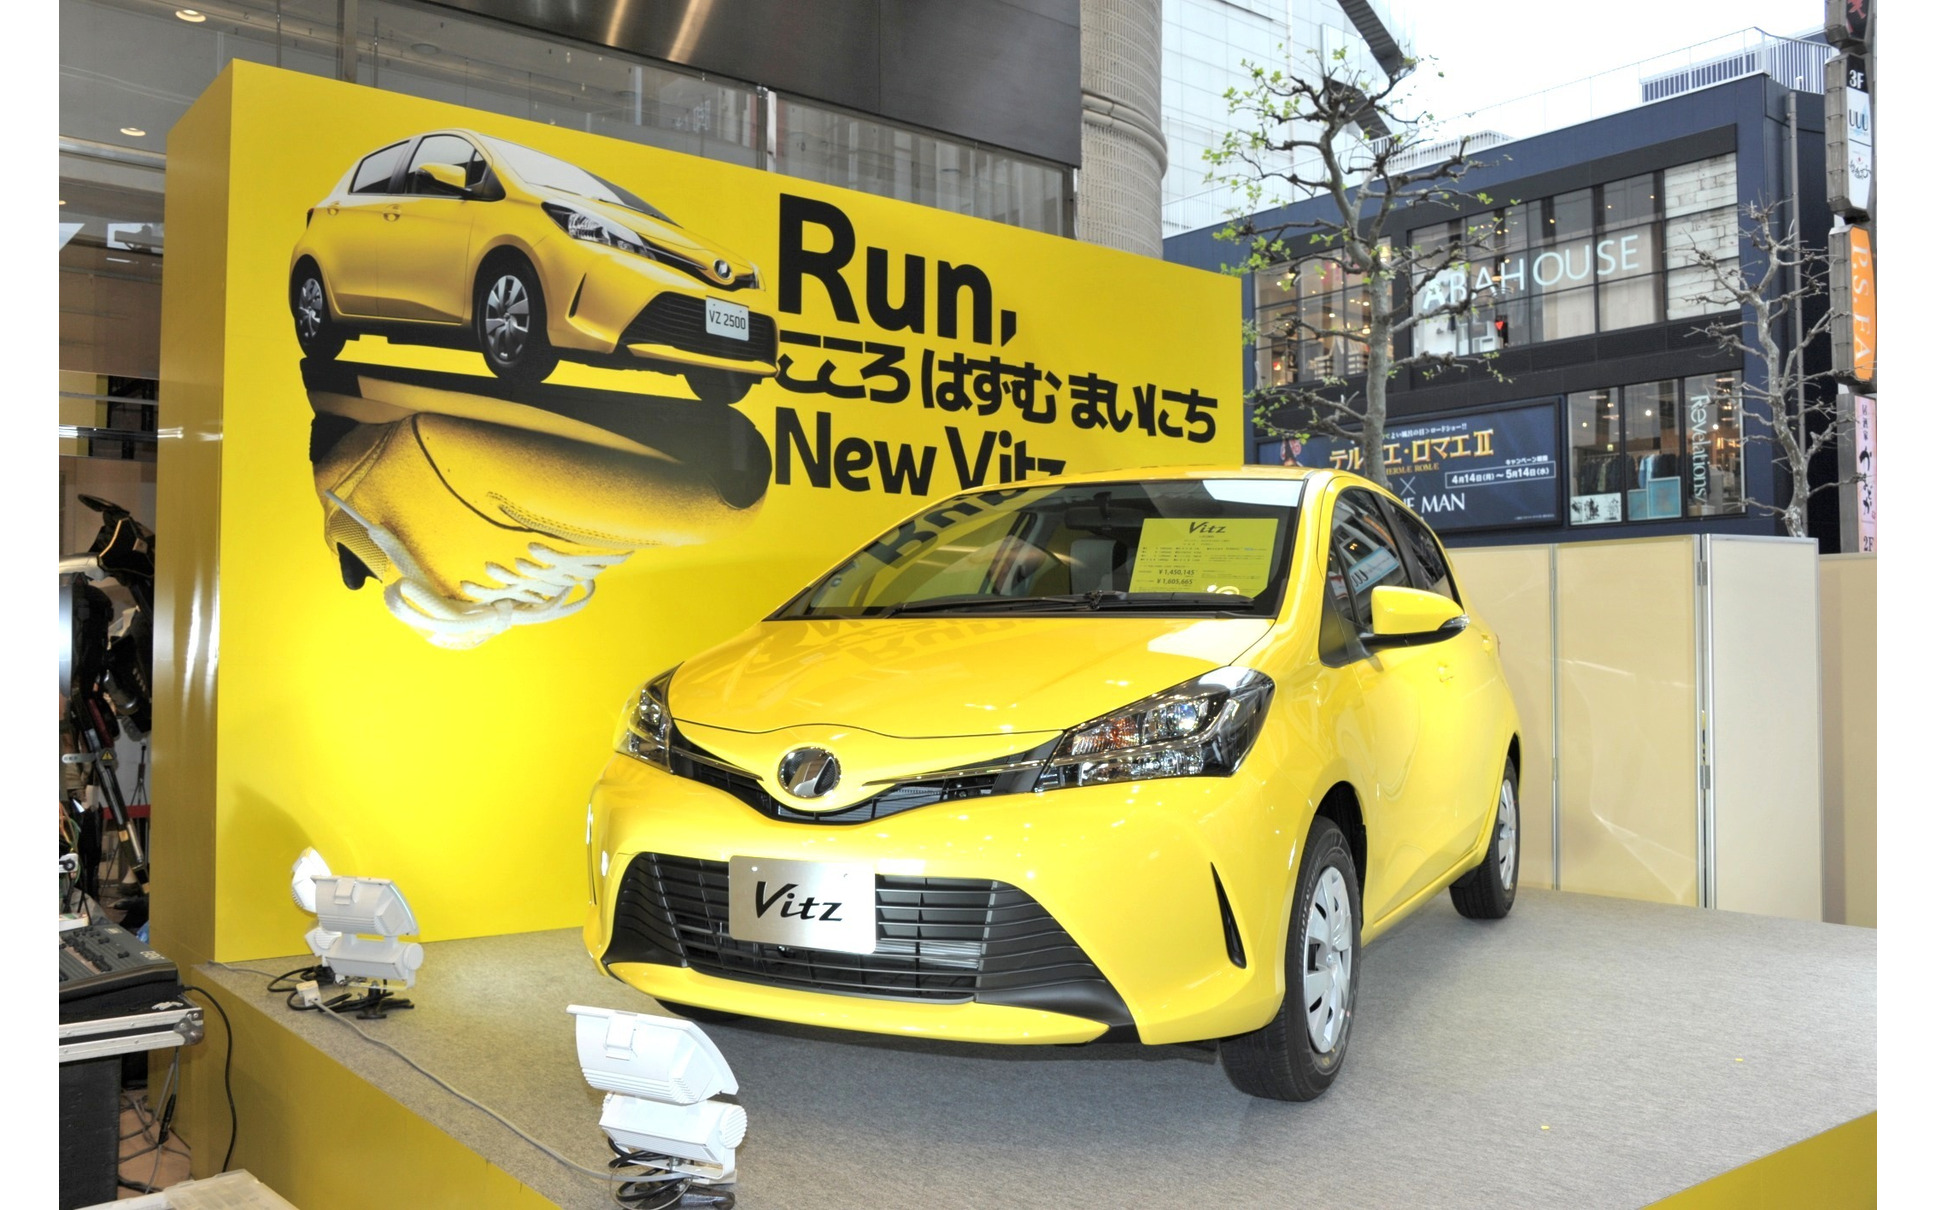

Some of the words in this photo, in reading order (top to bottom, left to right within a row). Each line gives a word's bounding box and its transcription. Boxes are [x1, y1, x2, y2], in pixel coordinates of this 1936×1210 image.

[1849, 69, 1865, 89] 3F
[778, 193, 1017, 346] Run,
[1423, 234, 1639, 309] ABAHOUSE
[709, 310, 721, 325] VZ
[724, 313, 746, 330] 2500
[777, 329, 911, 403] こころ
[921, 348, 1062, 424] はずむ
[1066, 371, 1218, 443] まいにち
[775, 406, 937, 496] New
[1421, 492, 1465, 513] MAN
[1189, 521, 1227, 534] Vitz
[1863, 535, 1873, 552] 2F
[755, 881, 842, 922] Vitz
